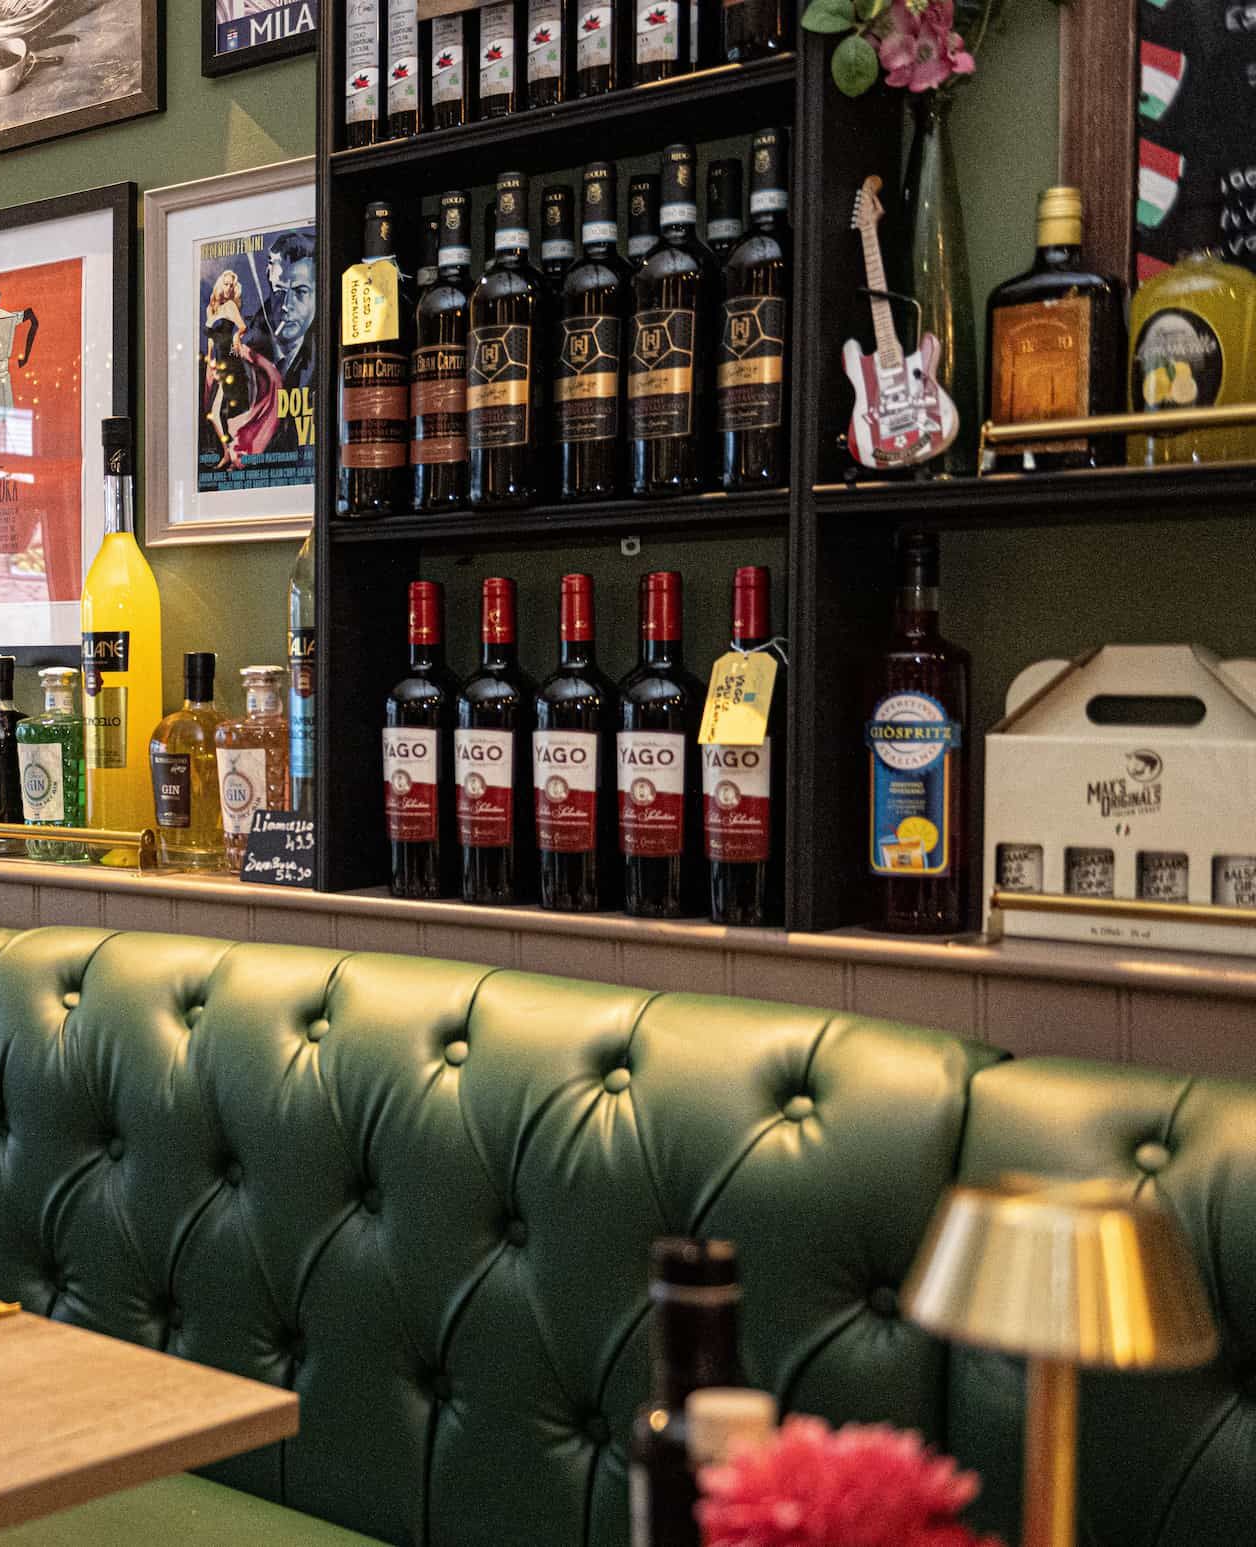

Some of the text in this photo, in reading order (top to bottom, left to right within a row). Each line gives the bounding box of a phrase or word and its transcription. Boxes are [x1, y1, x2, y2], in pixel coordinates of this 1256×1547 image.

[250, 3, 317, 46] MILA
[384, 742, 427, 759] YAGO
[455, 743, 503, 761] YAGO
[535, 746, 587, 764] YAGO
[619, 747, 674, 766] YAGO
[705, 750, 760, 769] YAGO
[26, 779, 45, 791] GIN
[161, 784, 180, 795] GIN
[226, 789, 246, 801] GIN
